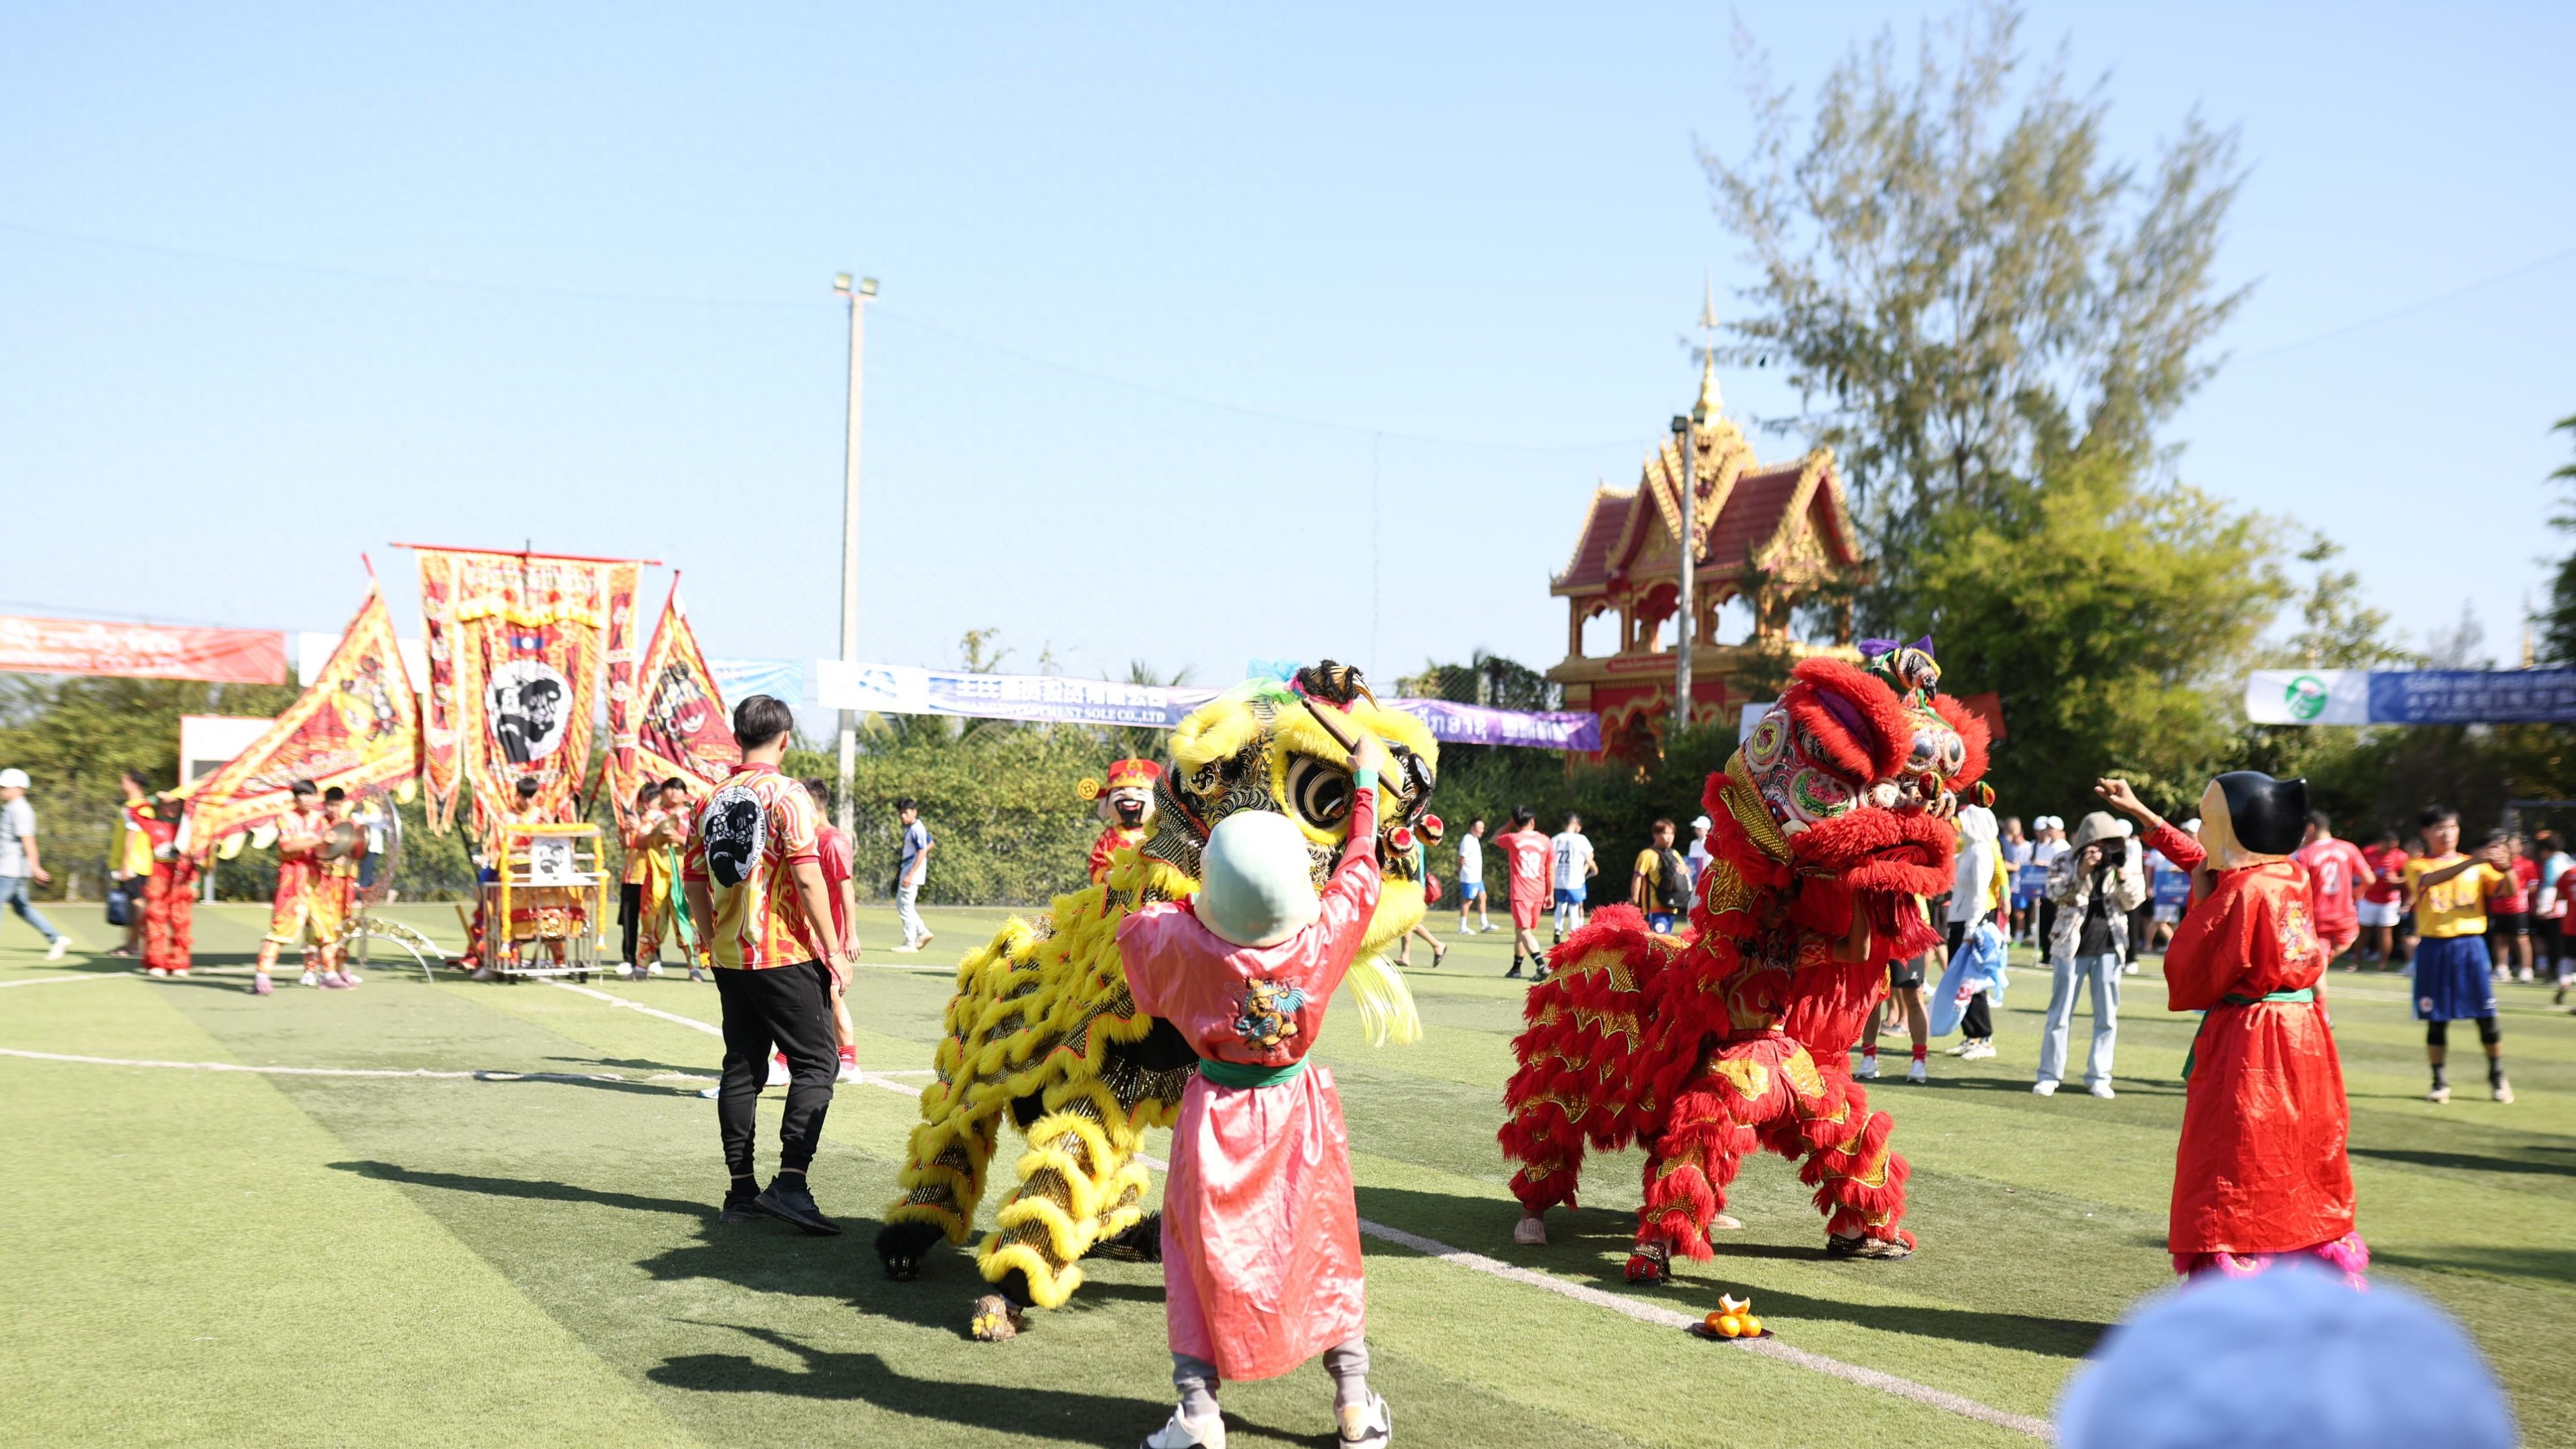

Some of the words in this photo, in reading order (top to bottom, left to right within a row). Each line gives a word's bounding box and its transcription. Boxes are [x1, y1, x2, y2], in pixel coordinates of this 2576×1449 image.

[1084, 707, 1116, 720] SOLE
[1117, 709, 1166, 723] CO.,LTD
[1558, 851, 1570, 864] 22
